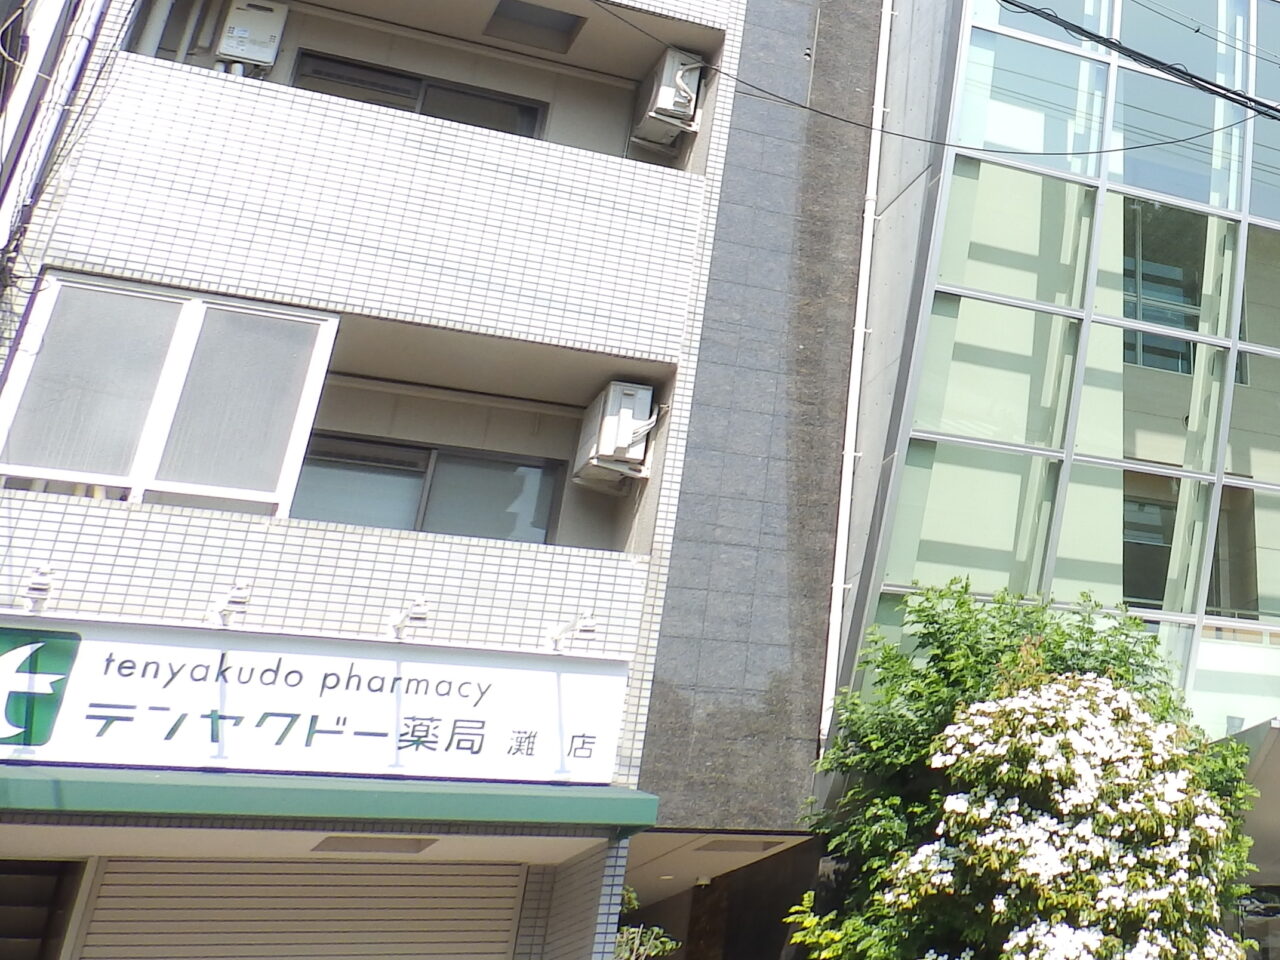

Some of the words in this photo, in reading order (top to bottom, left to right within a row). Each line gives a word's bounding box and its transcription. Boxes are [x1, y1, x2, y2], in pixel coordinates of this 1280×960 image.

[104, 652, 303, 689] tenyakudo
[319, 662, 492, 707] pharmacy
[85, 702, 486, 755] テンヤクドー薬局
